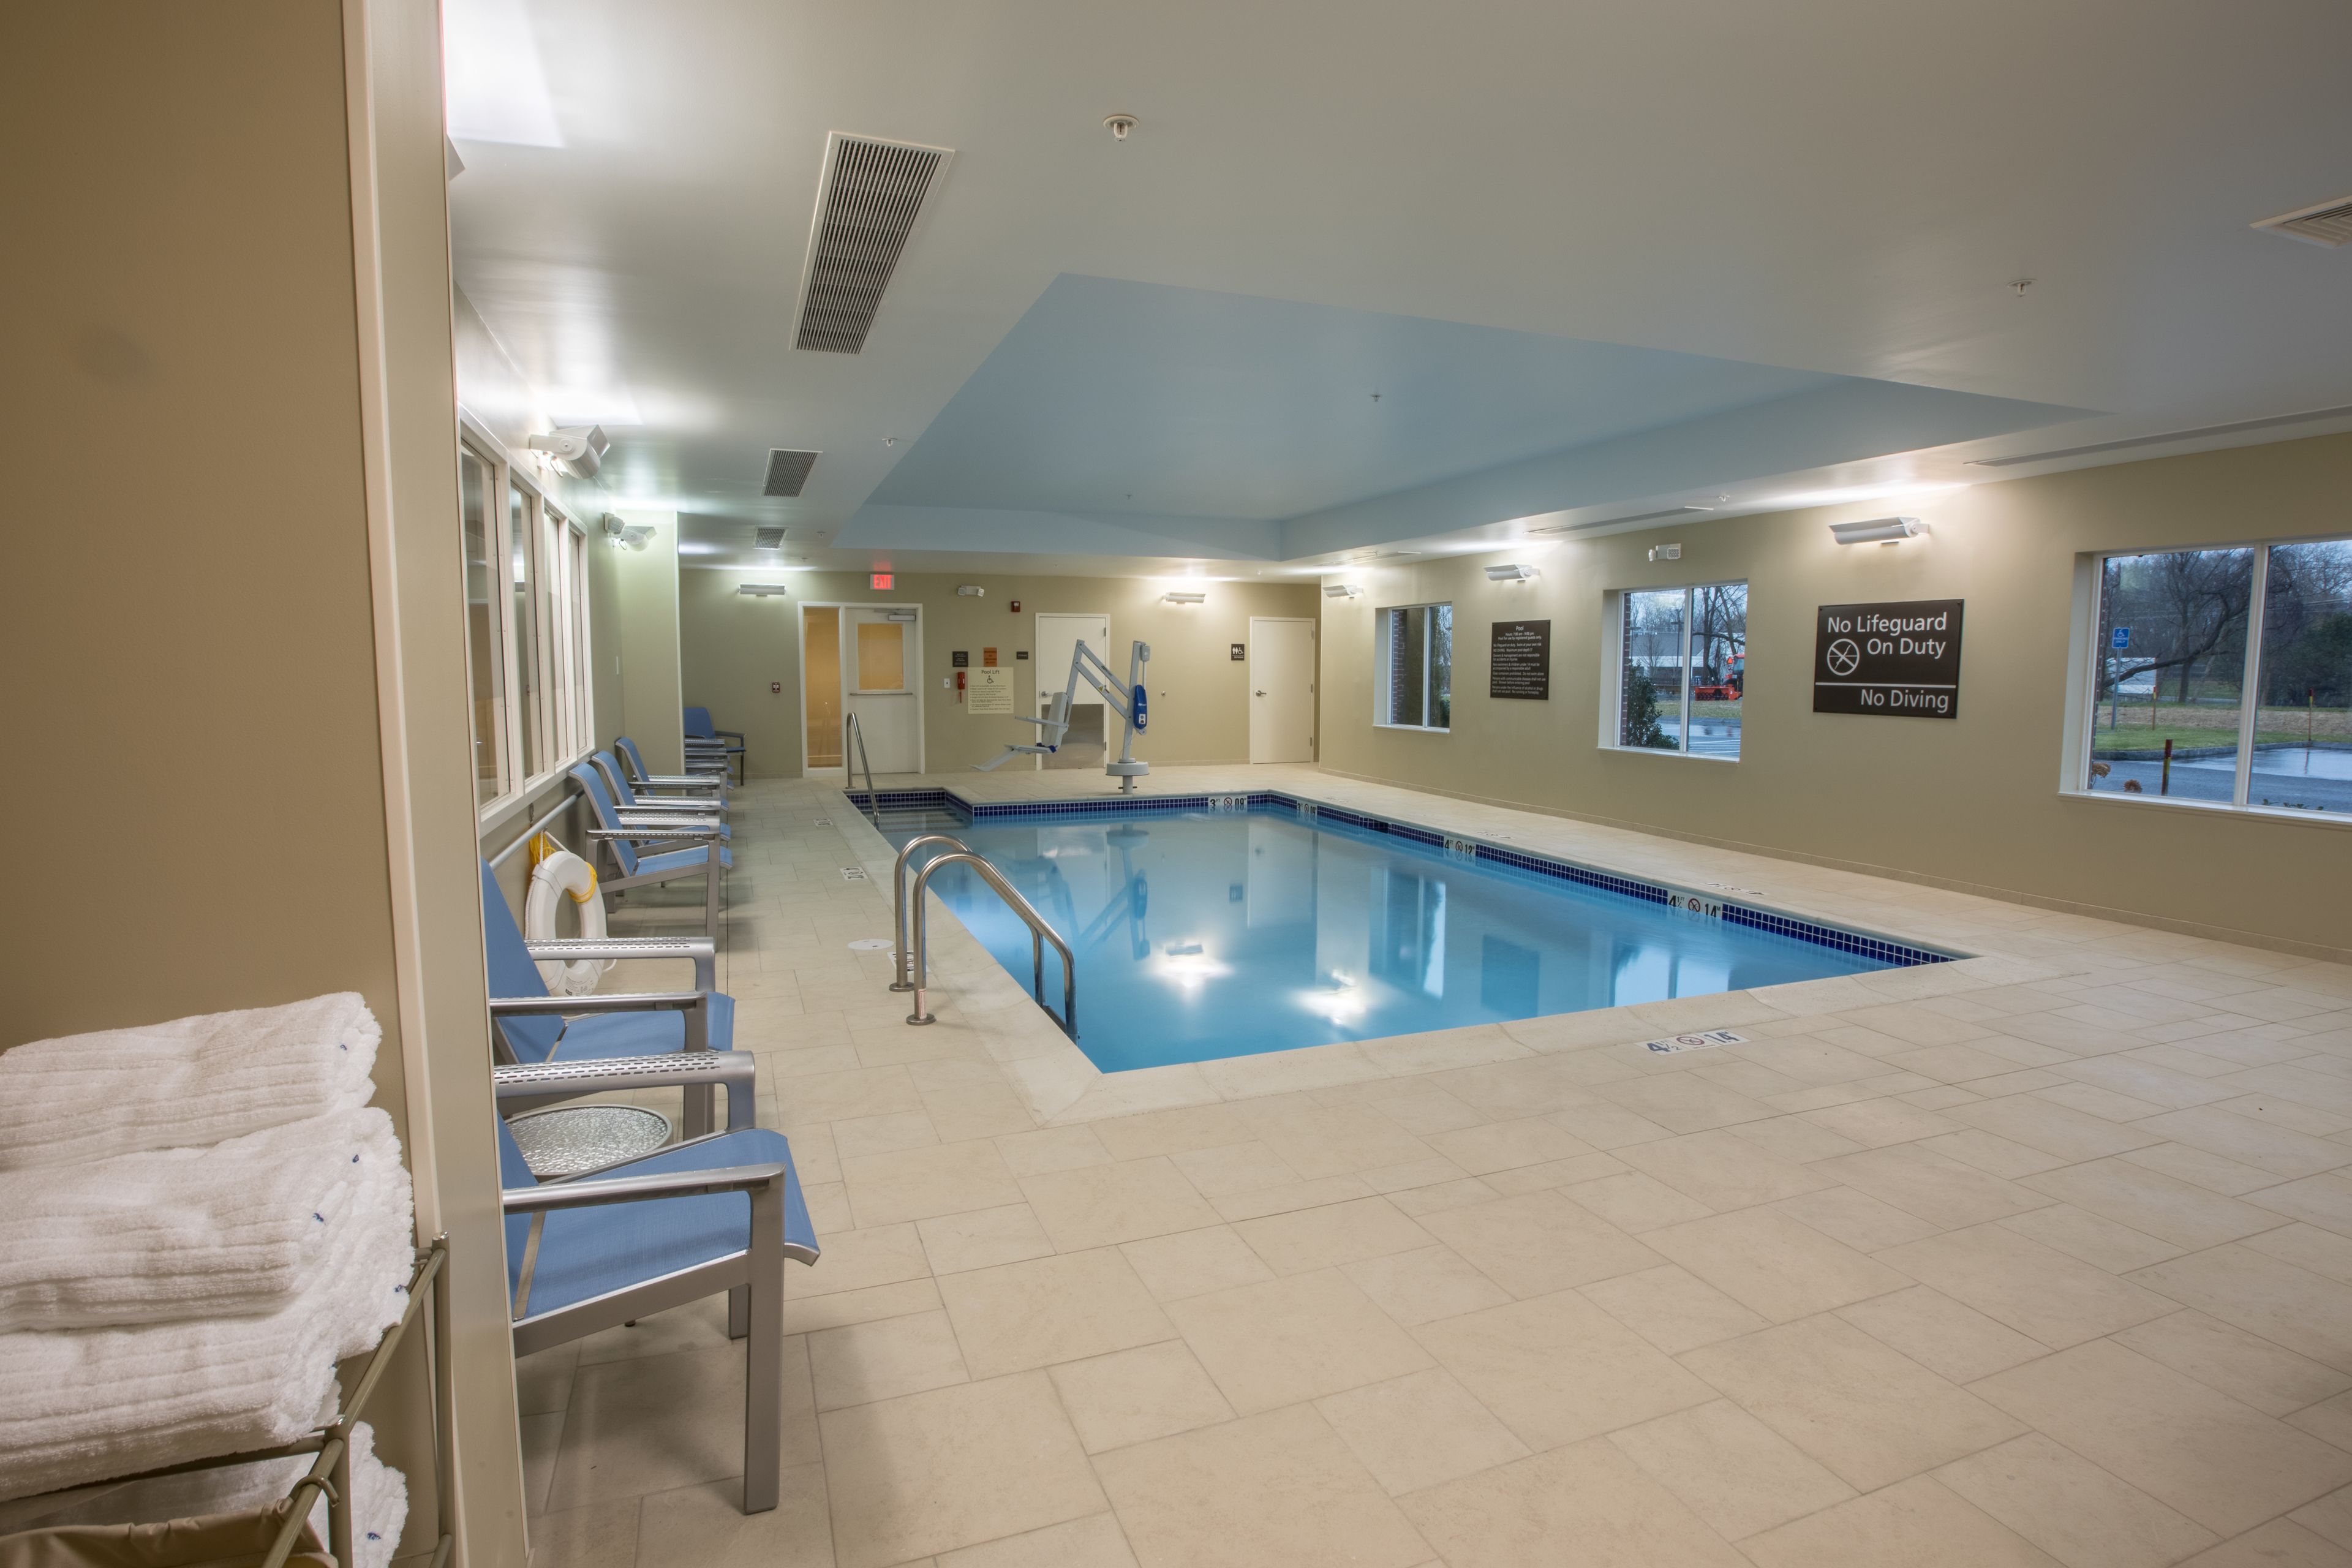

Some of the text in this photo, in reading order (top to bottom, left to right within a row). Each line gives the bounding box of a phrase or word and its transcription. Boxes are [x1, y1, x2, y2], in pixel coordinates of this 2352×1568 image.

[873, 575, 892, 589] EXIT
[1828, 612, 1947, 636] No Lifeguard
[1868, 638, 1947, 659] On Duty
[1861, 689, 1948, 713] No Diving
